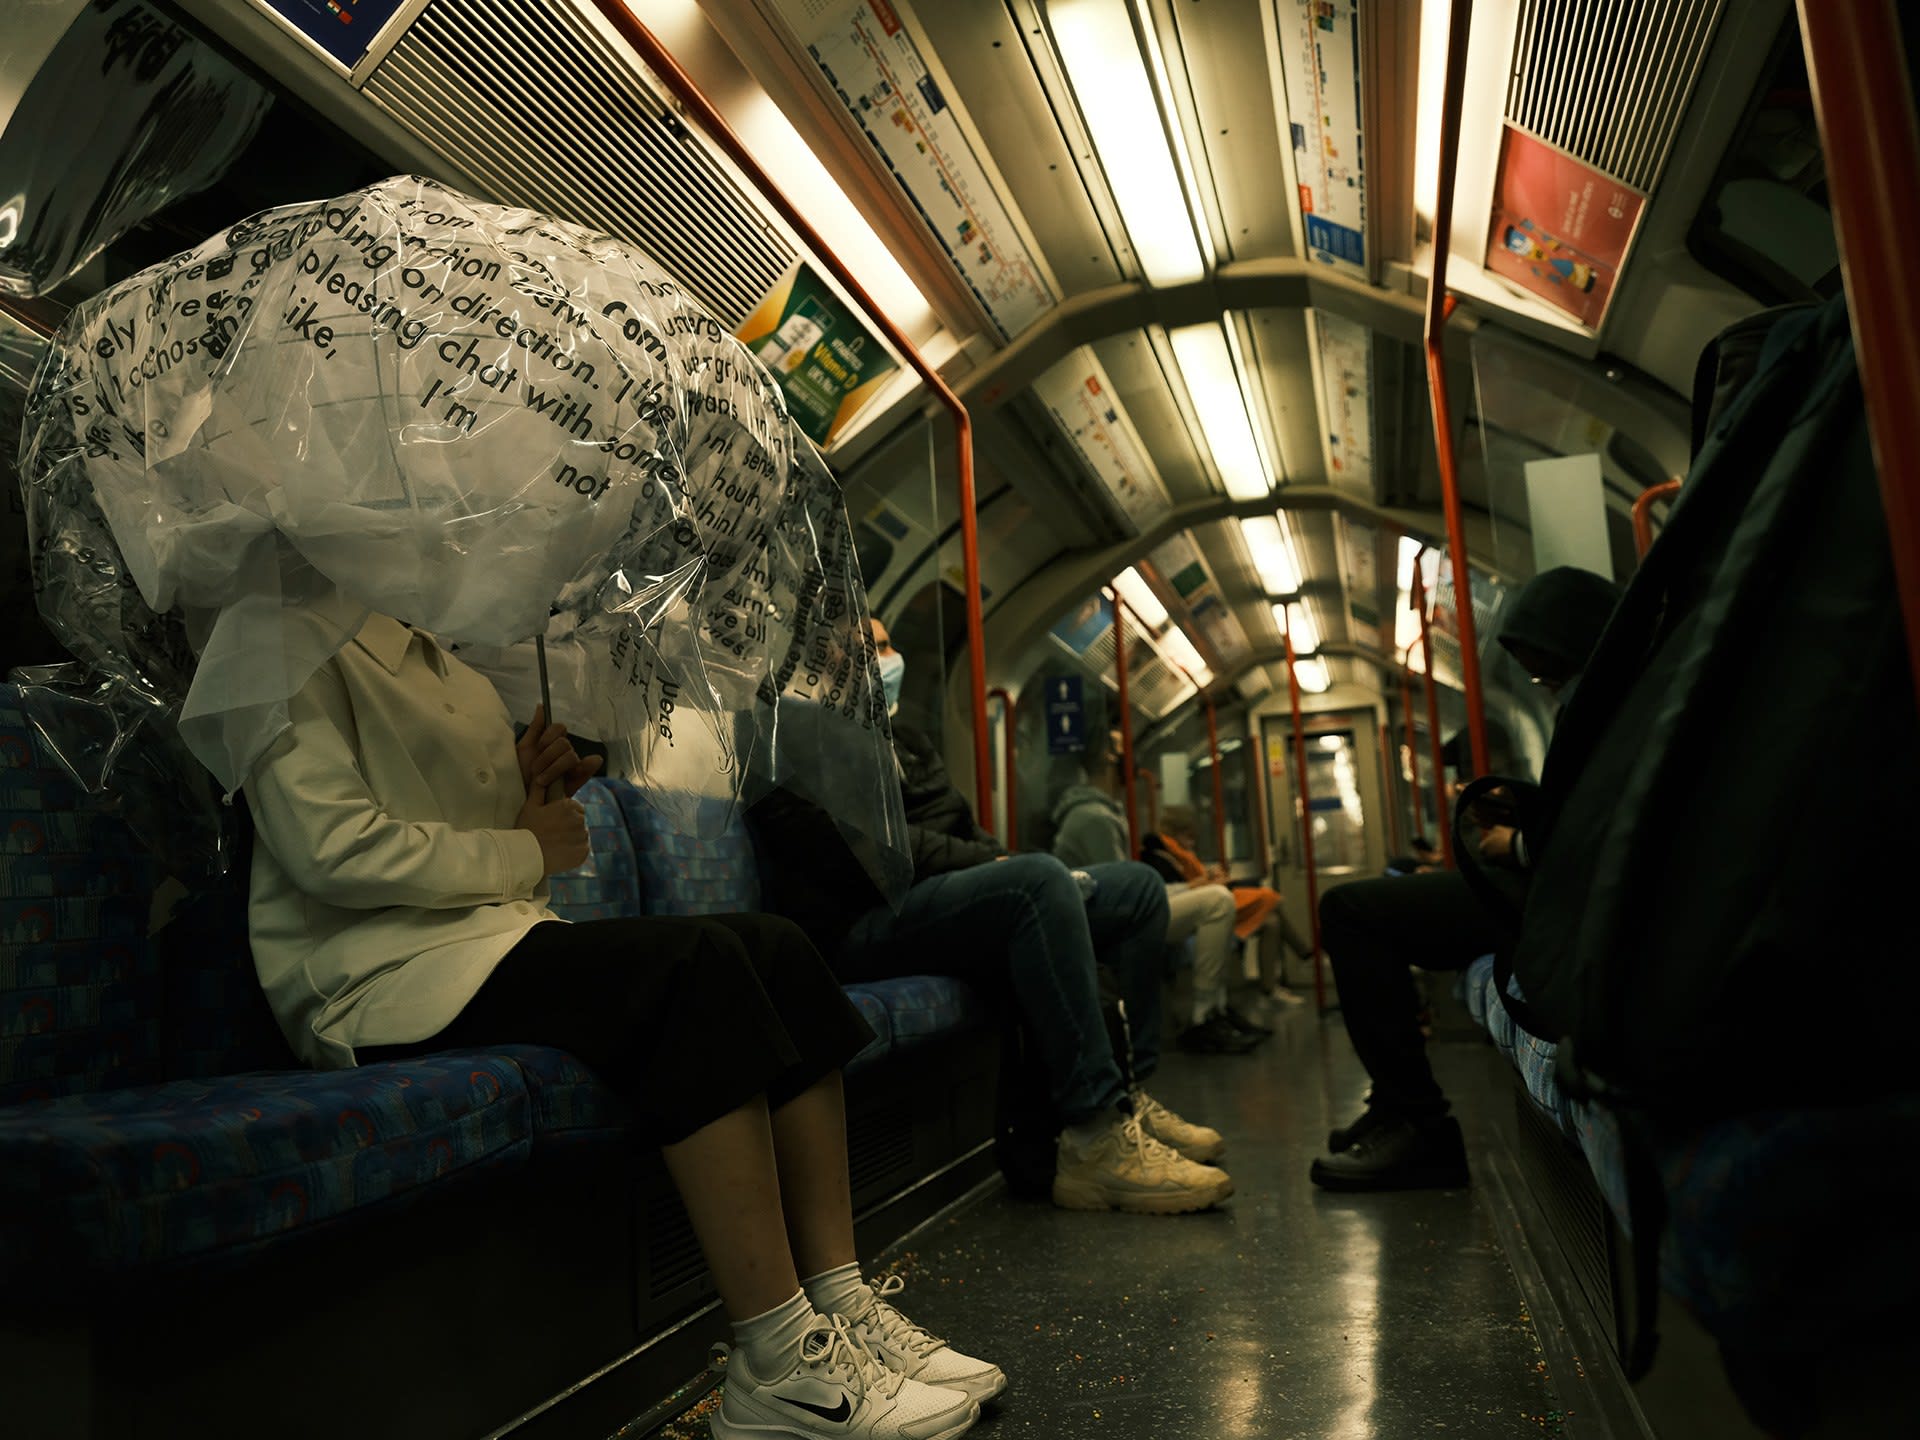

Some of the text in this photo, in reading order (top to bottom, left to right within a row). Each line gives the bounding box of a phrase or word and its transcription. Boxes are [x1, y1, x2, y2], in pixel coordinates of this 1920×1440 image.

[297, 249, 428, 350] pleasing
[402, 268, 444, 304] on
[451, 292, 599, 390] direction.
[420, 379, 613, 500] I'm not
[439, 338, 517, 393] chat
[526, 384, 593, 440] with
